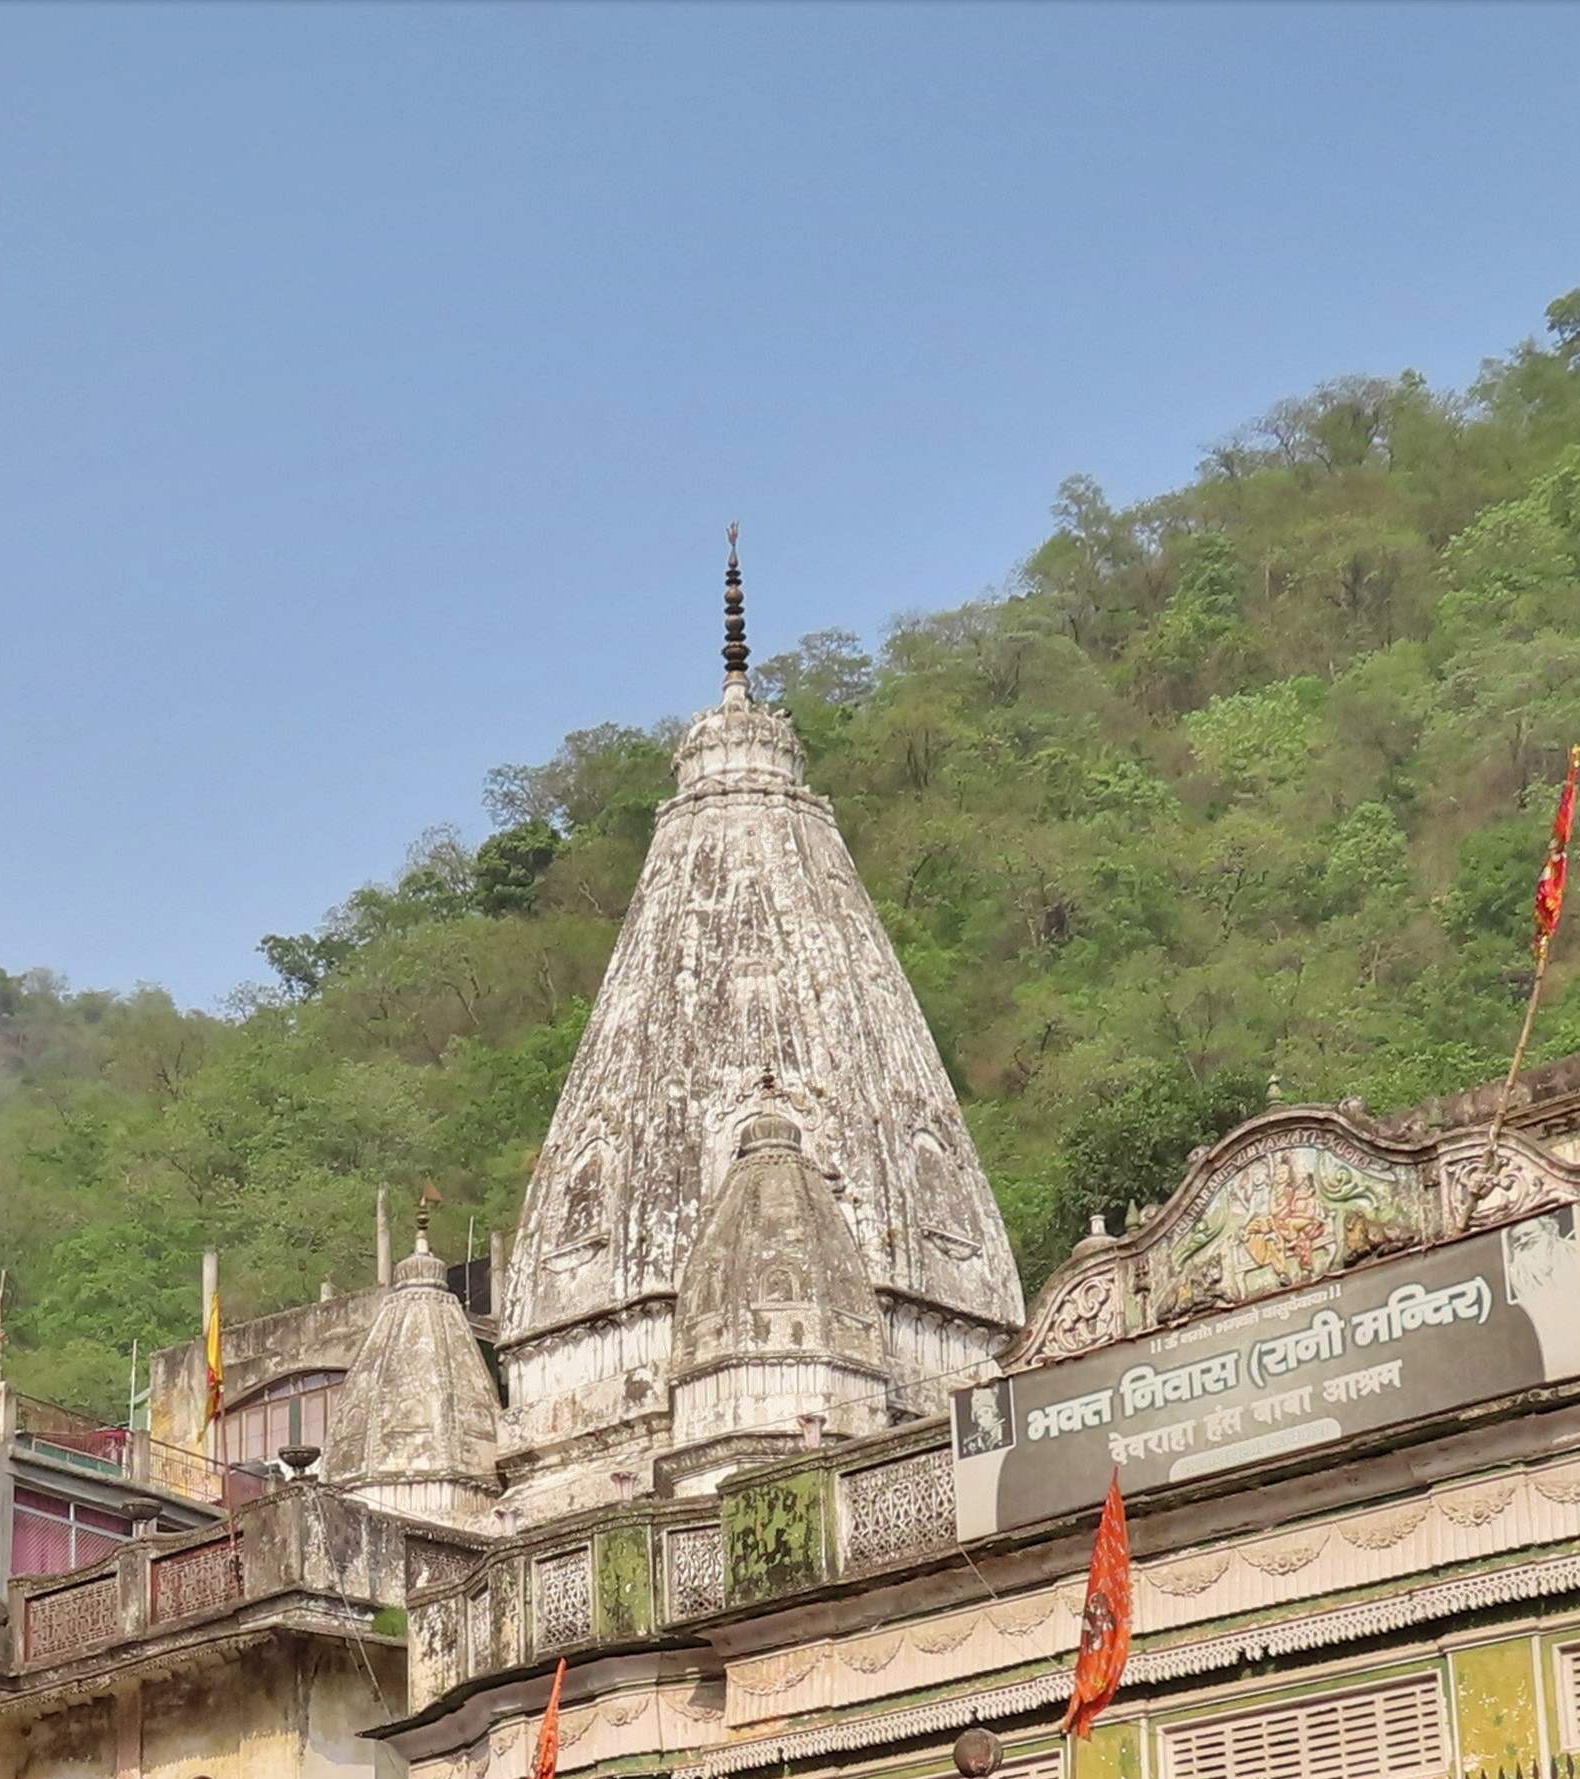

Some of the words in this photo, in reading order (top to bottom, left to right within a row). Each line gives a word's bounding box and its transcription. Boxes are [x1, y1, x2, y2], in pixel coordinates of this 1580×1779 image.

[1027, 1384, 1112, 1443] भक्त
[1120, 1343, 1238, 1417] निवास
[1248, 1311, 1345, 1387] (रानी
[1350, 1274, 1493, 1351] मन्दिर)
[1109, 1418, 1195, 1466] देवराहा
[1203, 1402, 1244, 1448] हंस
[1253, 1384, 1314, 1427] बाबा
[1323, 1360, 1404, 1405] आश्रम
